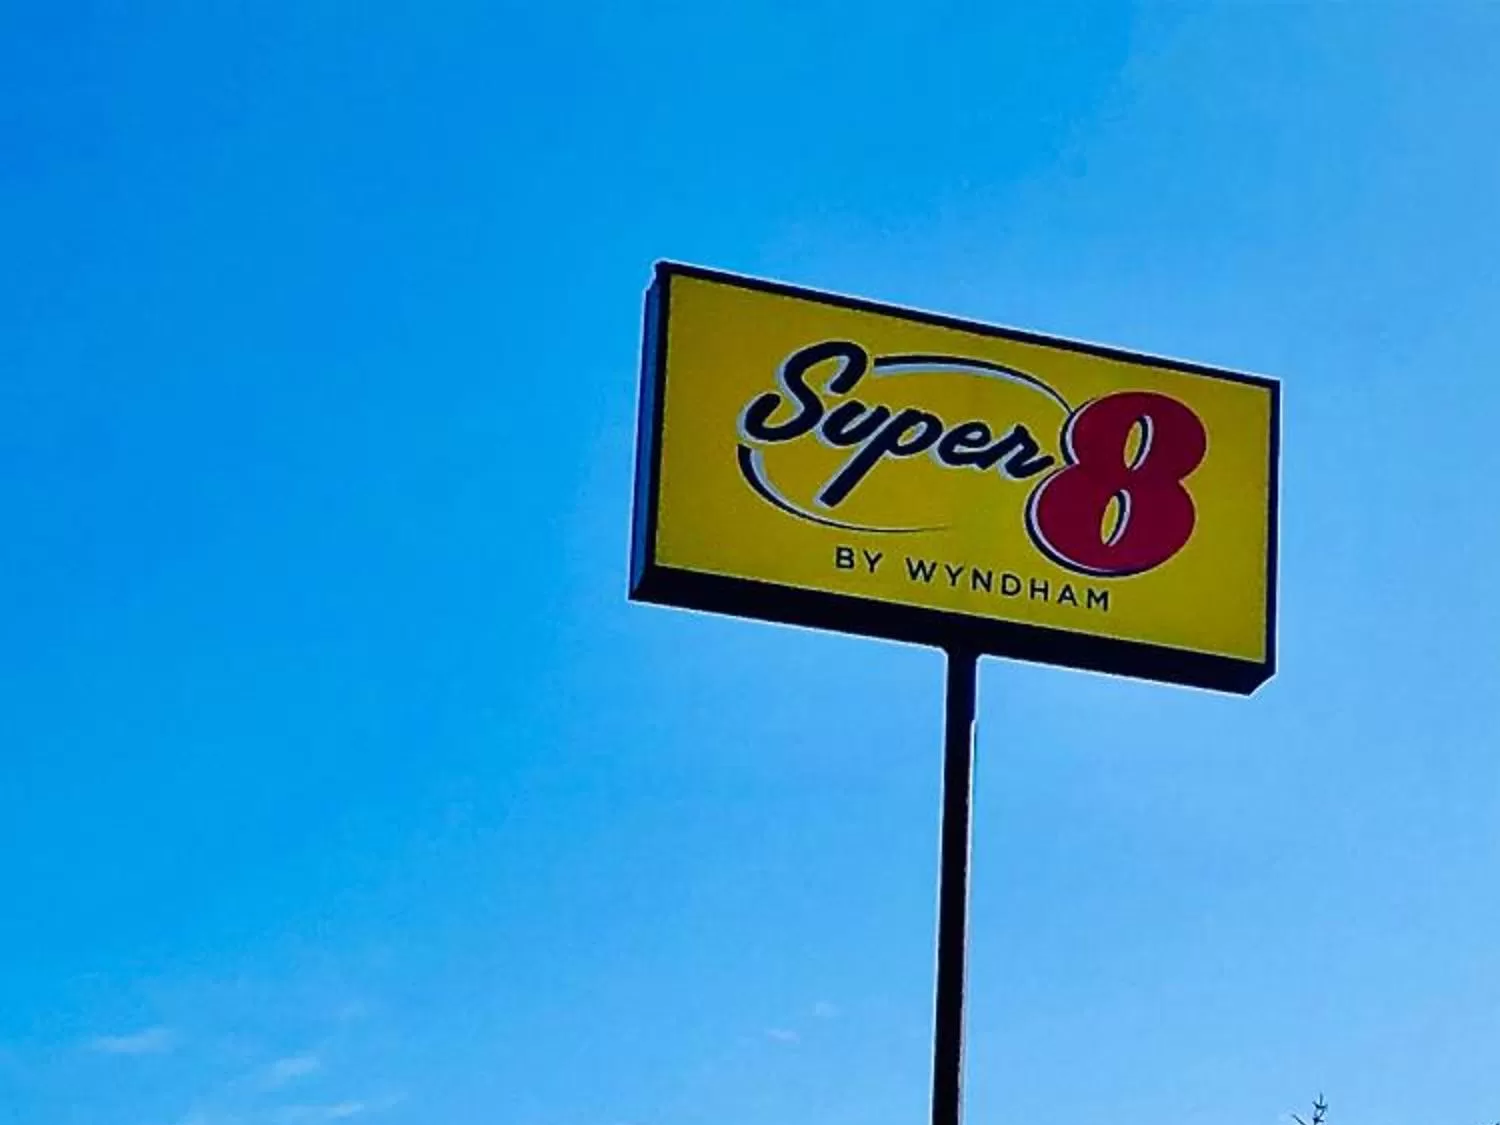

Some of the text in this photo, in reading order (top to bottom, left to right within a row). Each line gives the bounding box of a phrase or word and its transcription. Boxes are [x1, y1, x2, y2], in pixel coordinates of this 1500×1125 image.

[741, 340, 1208, 577] Super 8
[835, 547, 1110, 612] BY WYNDHAM
